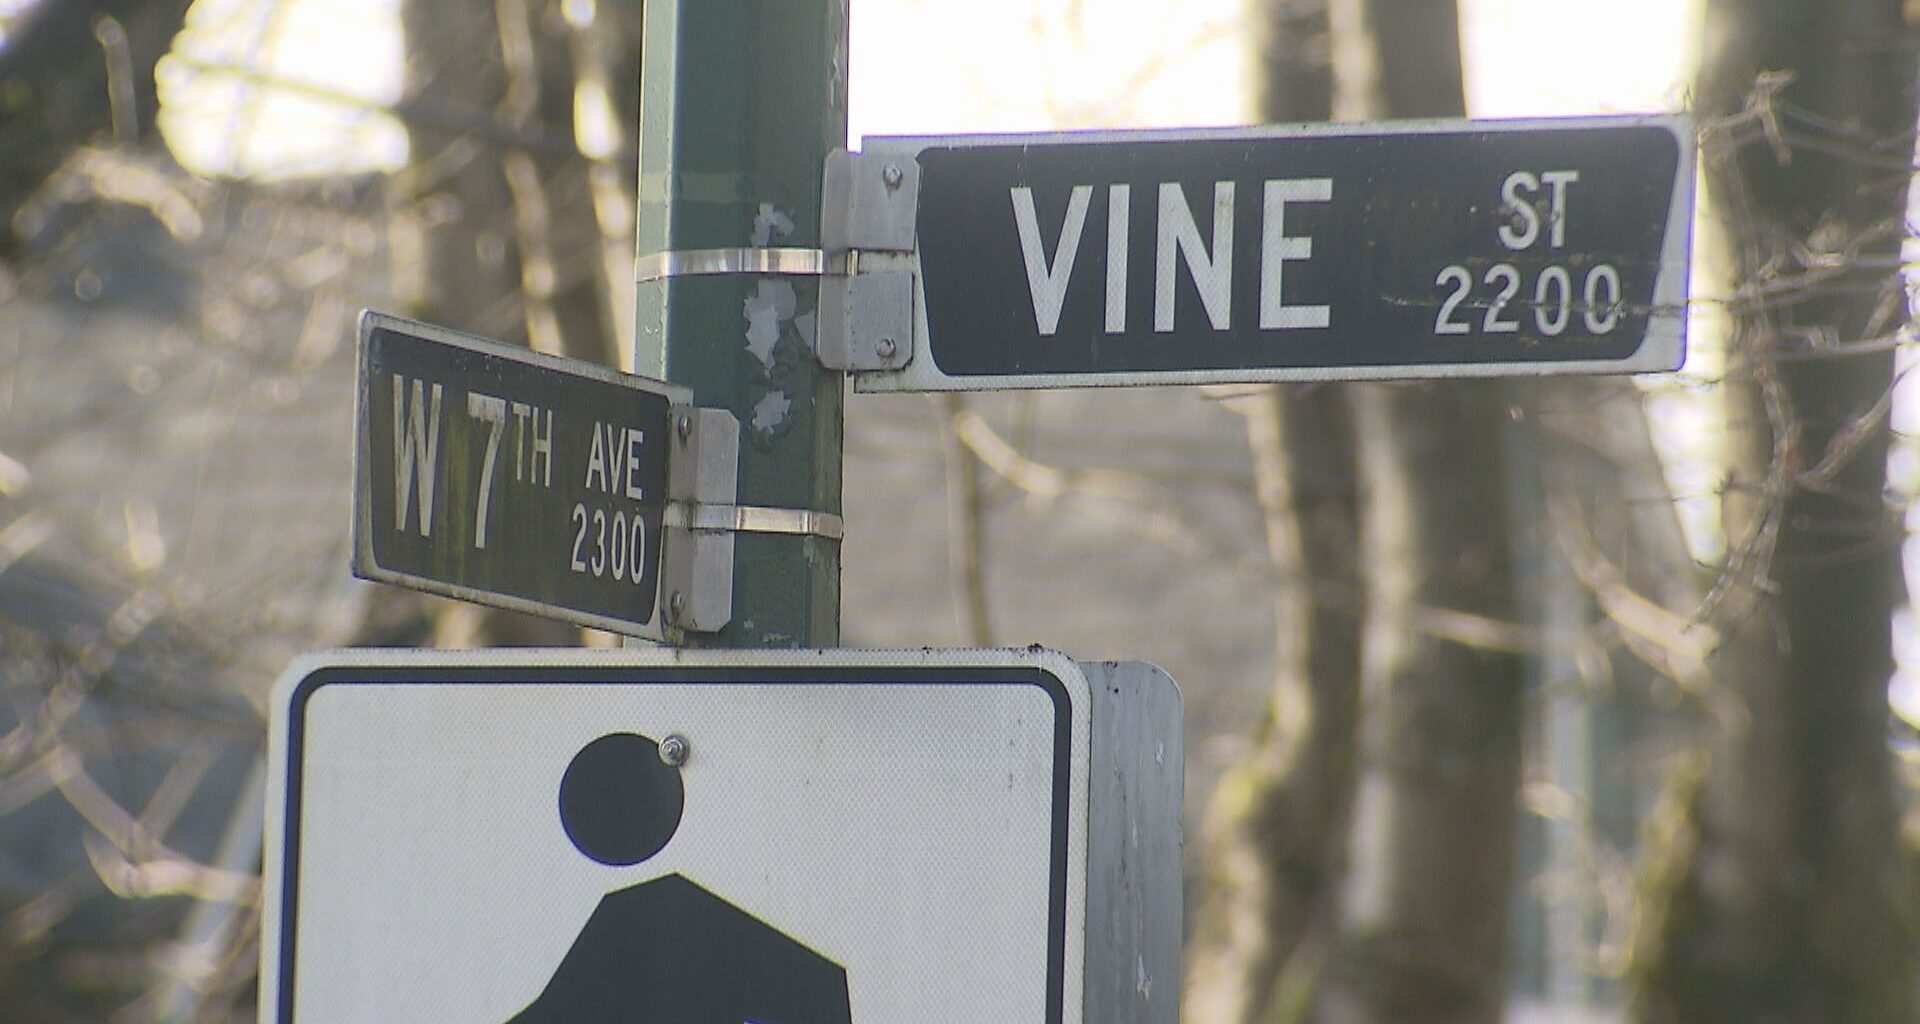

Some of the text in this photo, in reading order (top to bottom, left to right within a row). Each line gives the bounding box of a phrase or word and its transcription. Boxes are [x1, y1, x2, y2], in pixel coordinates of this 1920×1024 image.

[1009, 170, 1580, 336] VINE ST
[1433, 263, 1623, 336] 2200
[392, 374, 644, 549] W 7TH AVE
[570, 502, 647, 585] 2300
